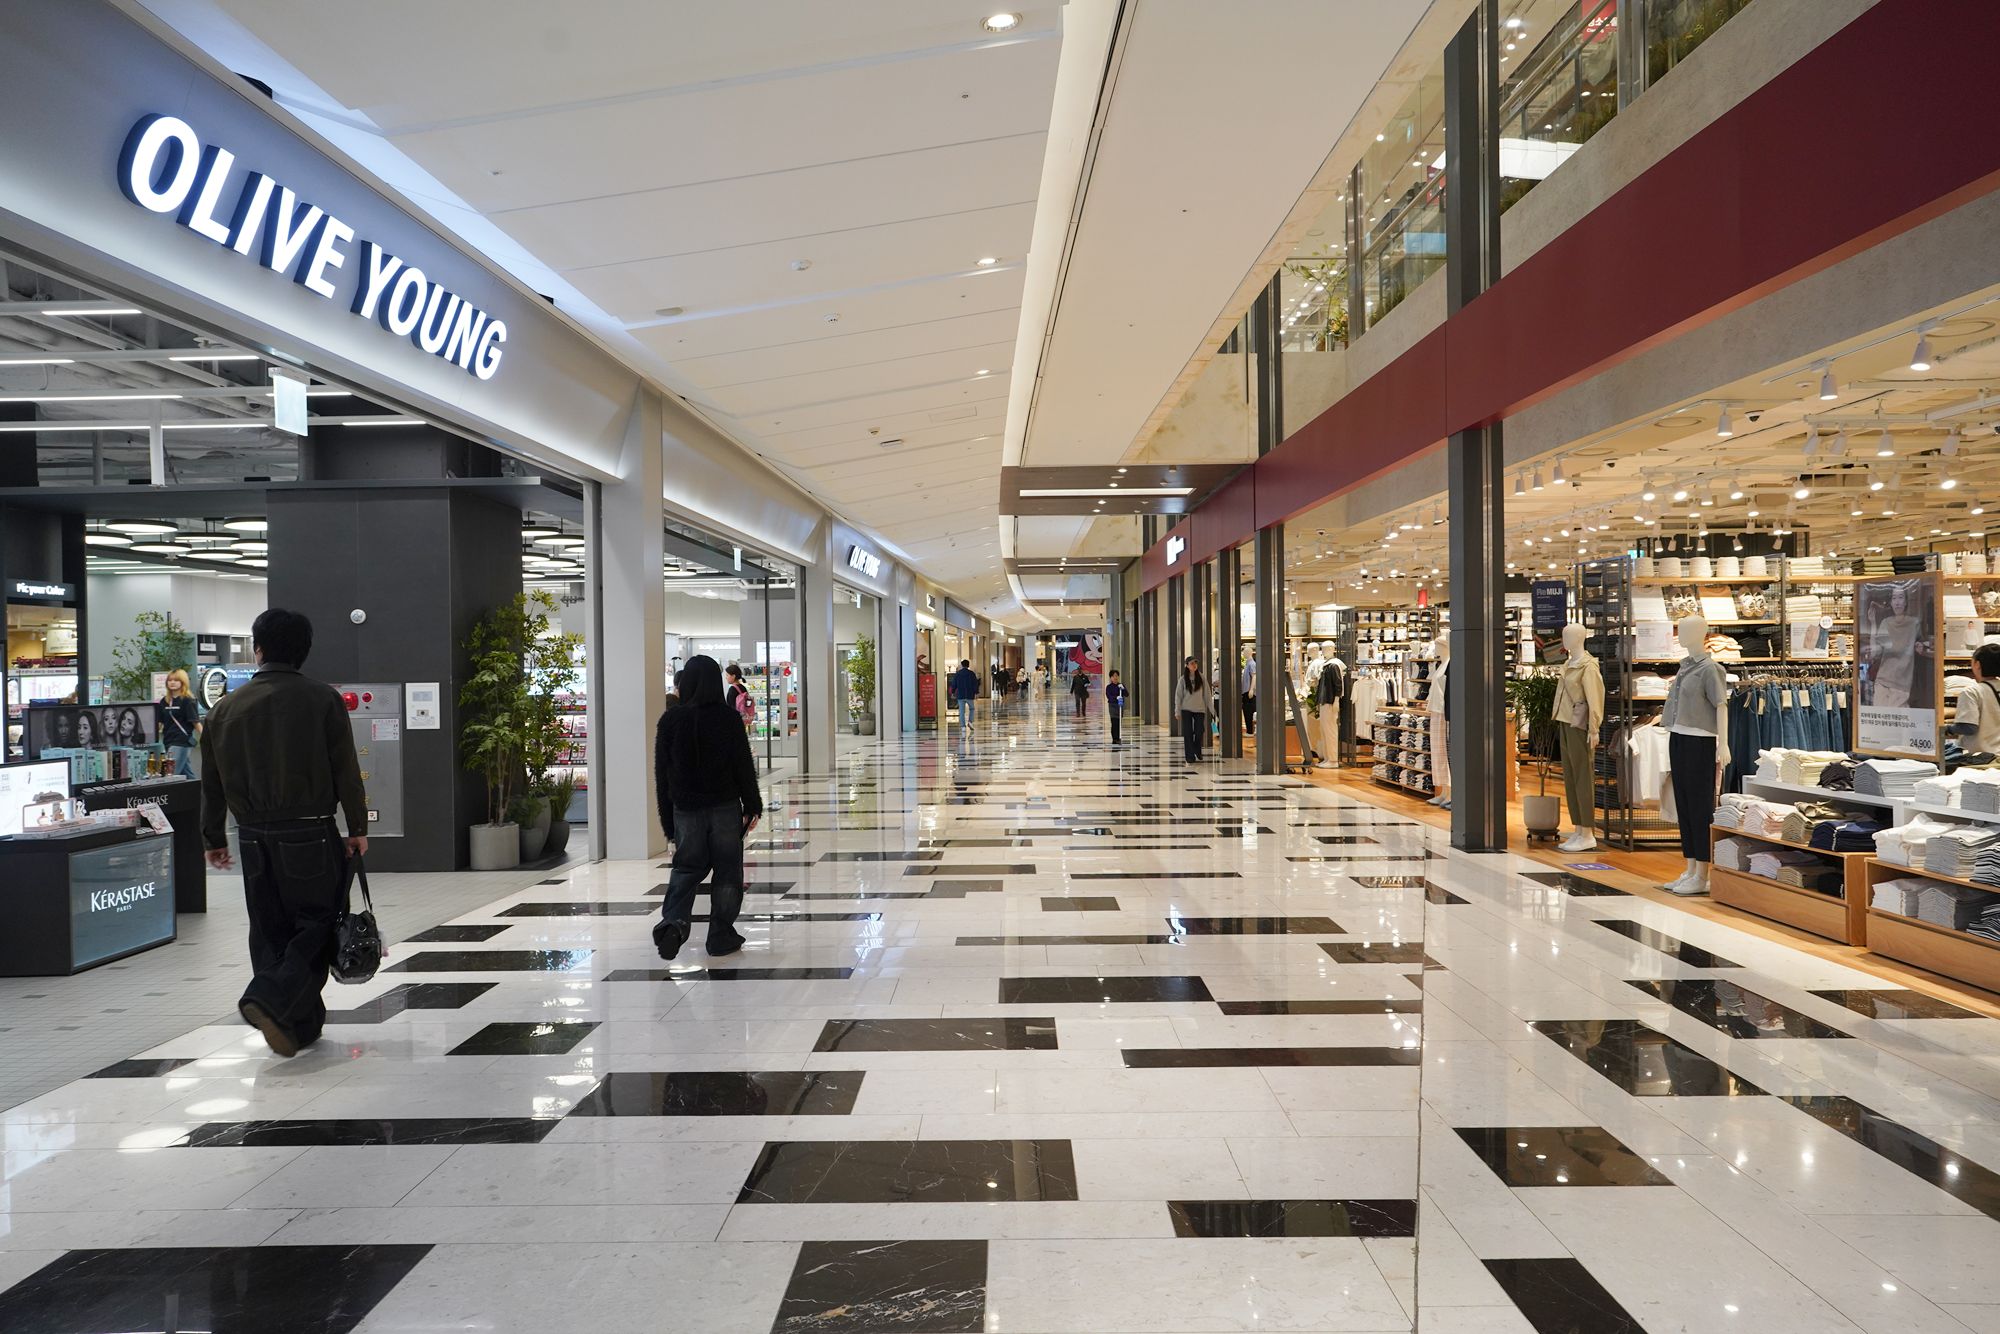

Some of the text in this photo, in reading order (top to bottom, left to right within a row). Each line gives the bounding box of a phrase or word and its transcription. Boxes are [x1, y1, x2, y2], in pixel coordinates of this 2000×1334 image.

[119, 113, 507, 381] OLIVE YOUNG
[1909, 738, 1932, 749] 24,900
[91, 881, 156, 913] KÉRASTASE
[116, 904, 132, 913] PARIS
